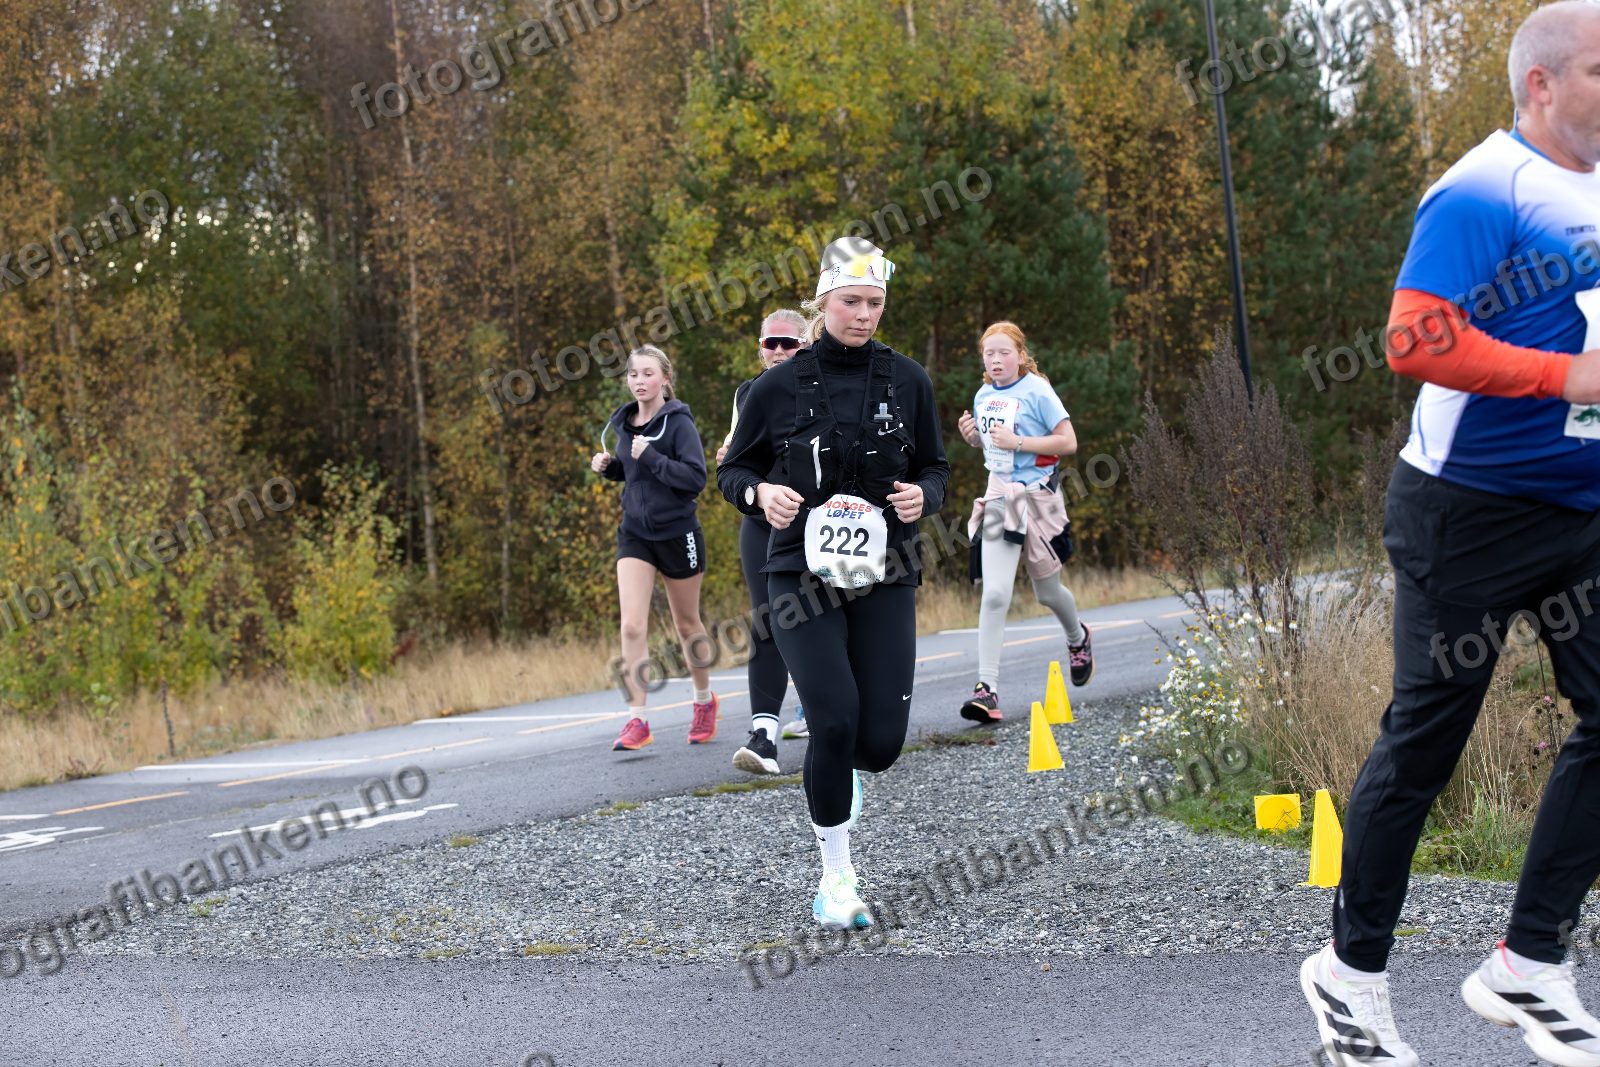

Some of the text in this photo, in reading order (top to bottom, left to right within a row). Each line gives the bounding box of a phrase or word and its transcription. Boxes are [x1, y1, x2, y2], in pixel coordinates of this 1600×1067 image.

[824, 500, 872, 512] NORGES
[827, 508, 864, 519] LØPET
[686, 531, 698, 569] adidas
[819, 524, 869, 556] 222
